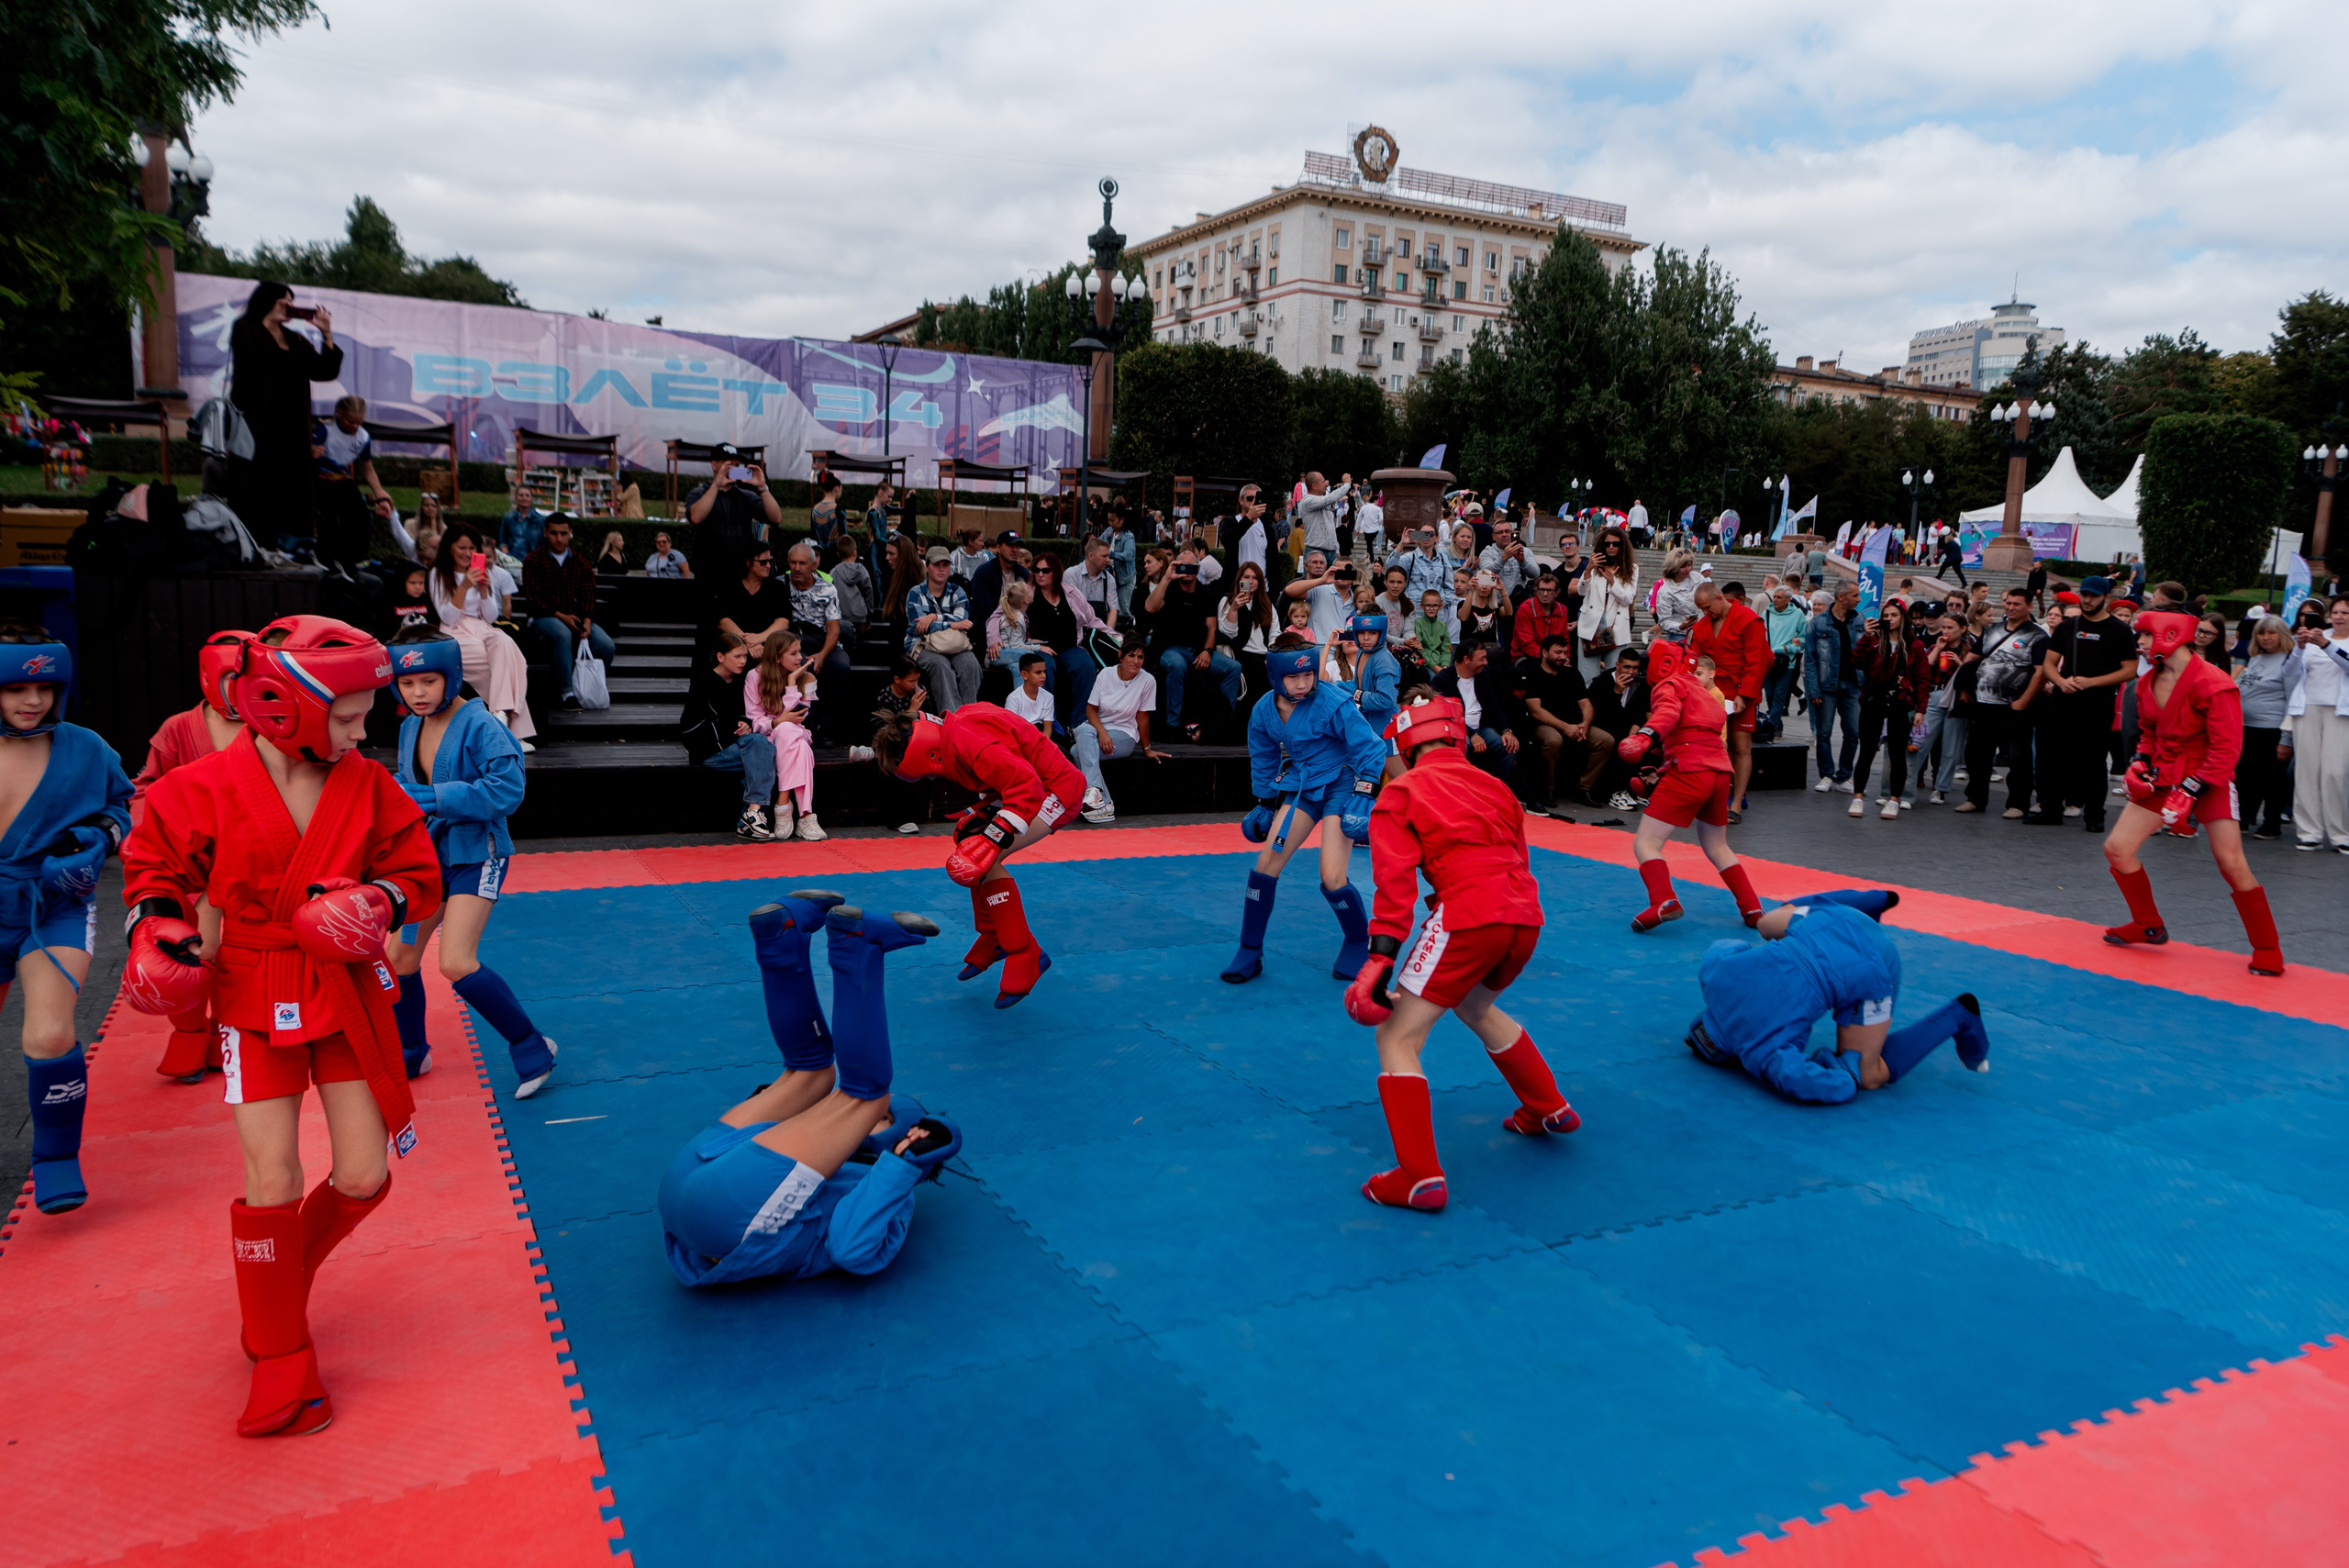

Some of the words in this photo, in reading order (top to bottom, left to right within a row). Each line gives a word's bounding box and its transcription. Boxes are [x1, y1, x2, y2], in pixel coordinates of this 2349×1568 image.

[411, 351, 786, 417] ВЗЛЁТ
[813, 383, 944, 428] 34
[986, 891, 1009, 901] GREEN
[988, 896, 1008, 906] HILL
[1413, 923, 1441, 973] САМБО
